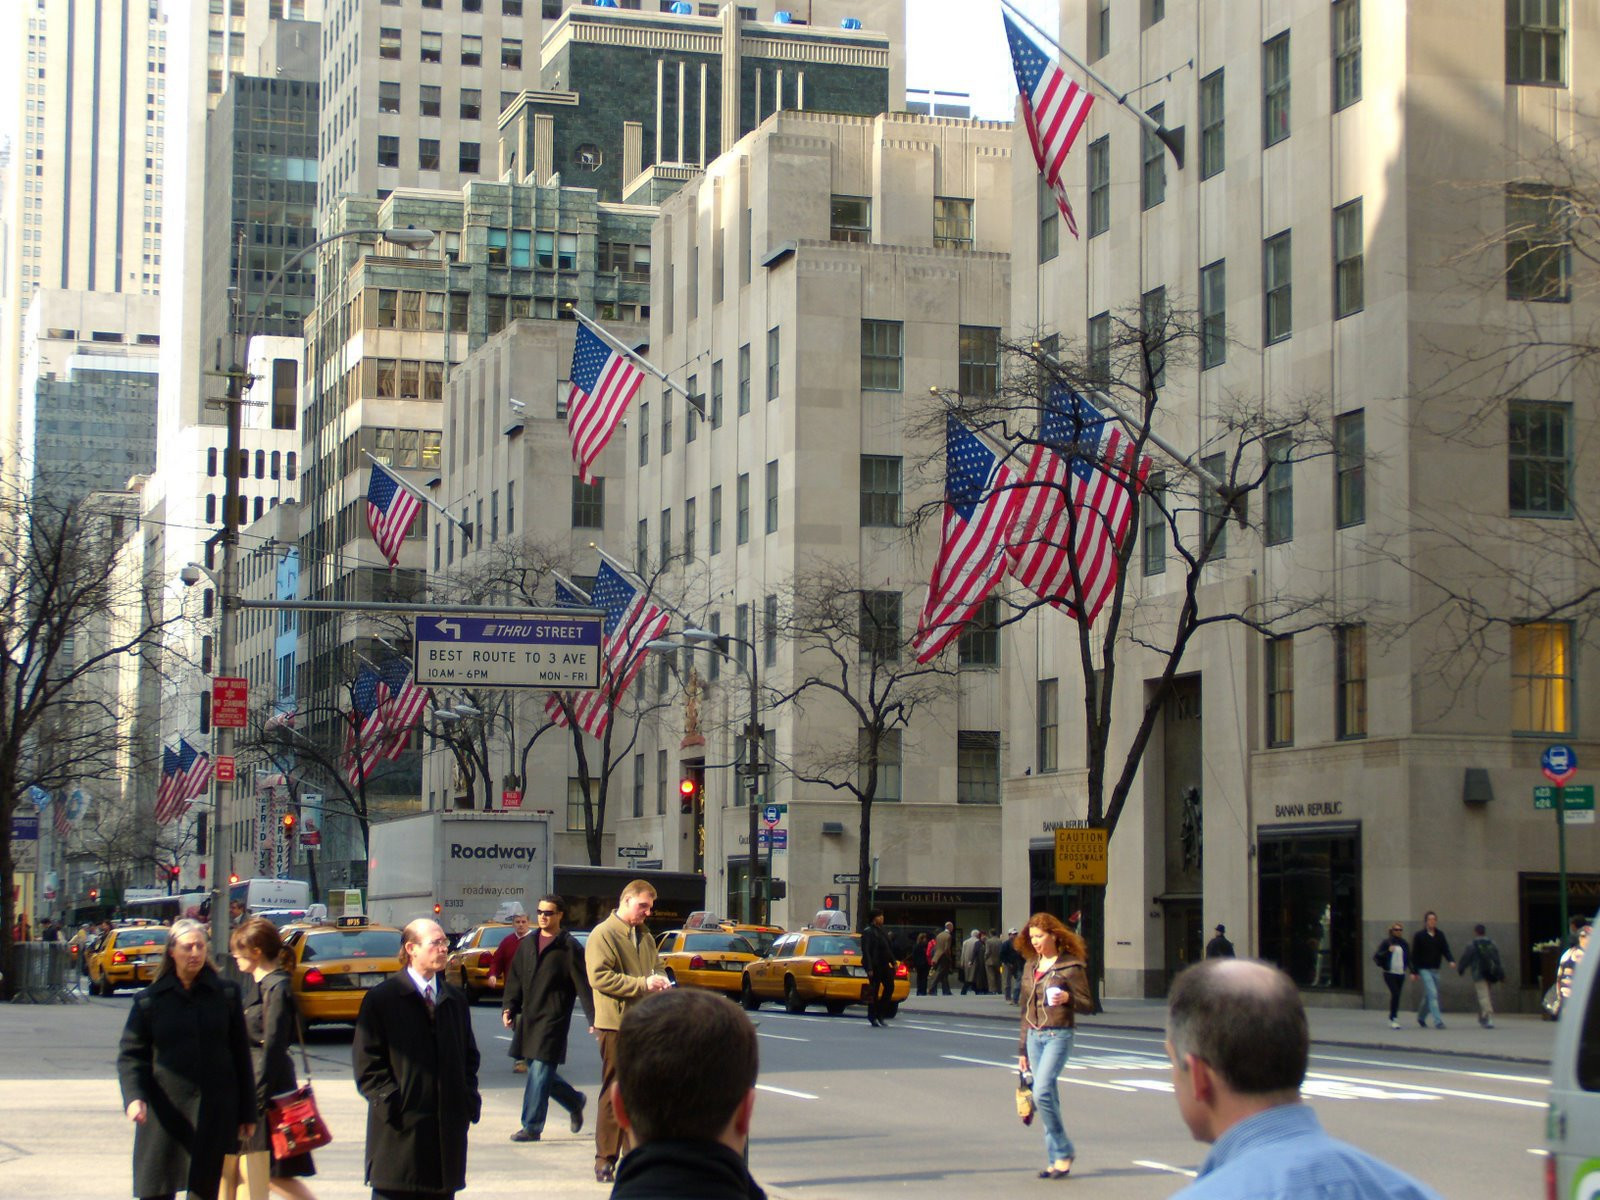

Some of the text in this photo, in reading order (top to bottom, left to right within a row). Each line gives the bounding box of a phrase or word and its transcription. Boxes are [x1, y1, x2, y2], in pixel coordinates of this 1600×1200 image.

[496, 624, 584, 639] THRU STREET
[429, 649, 587, 665] BEST ROUTE TO 3 AVE
[428, 668, 455, 678] 10AM
[466, 669, 488, 679] 6PM
[539, 671, 561, 681] MON
[572, 671, 588, 681] FRI
[1275, 801, 1343, 817] BANANA REPUBLIC
[1060, 832, 1103, 842] CAUTION
[450, 843, 536, 862] Roadway
[1060, 844, 1104, 853] RECESSED
[1059, 852, 1104, 861] CROSSWALK
[499, 862, 531, 871] your way
[1075, 862, 1088, 870] ON
[1068, 871, 1095, 881] 5 AVE
[462, 884, 524, 897] roadway.com
